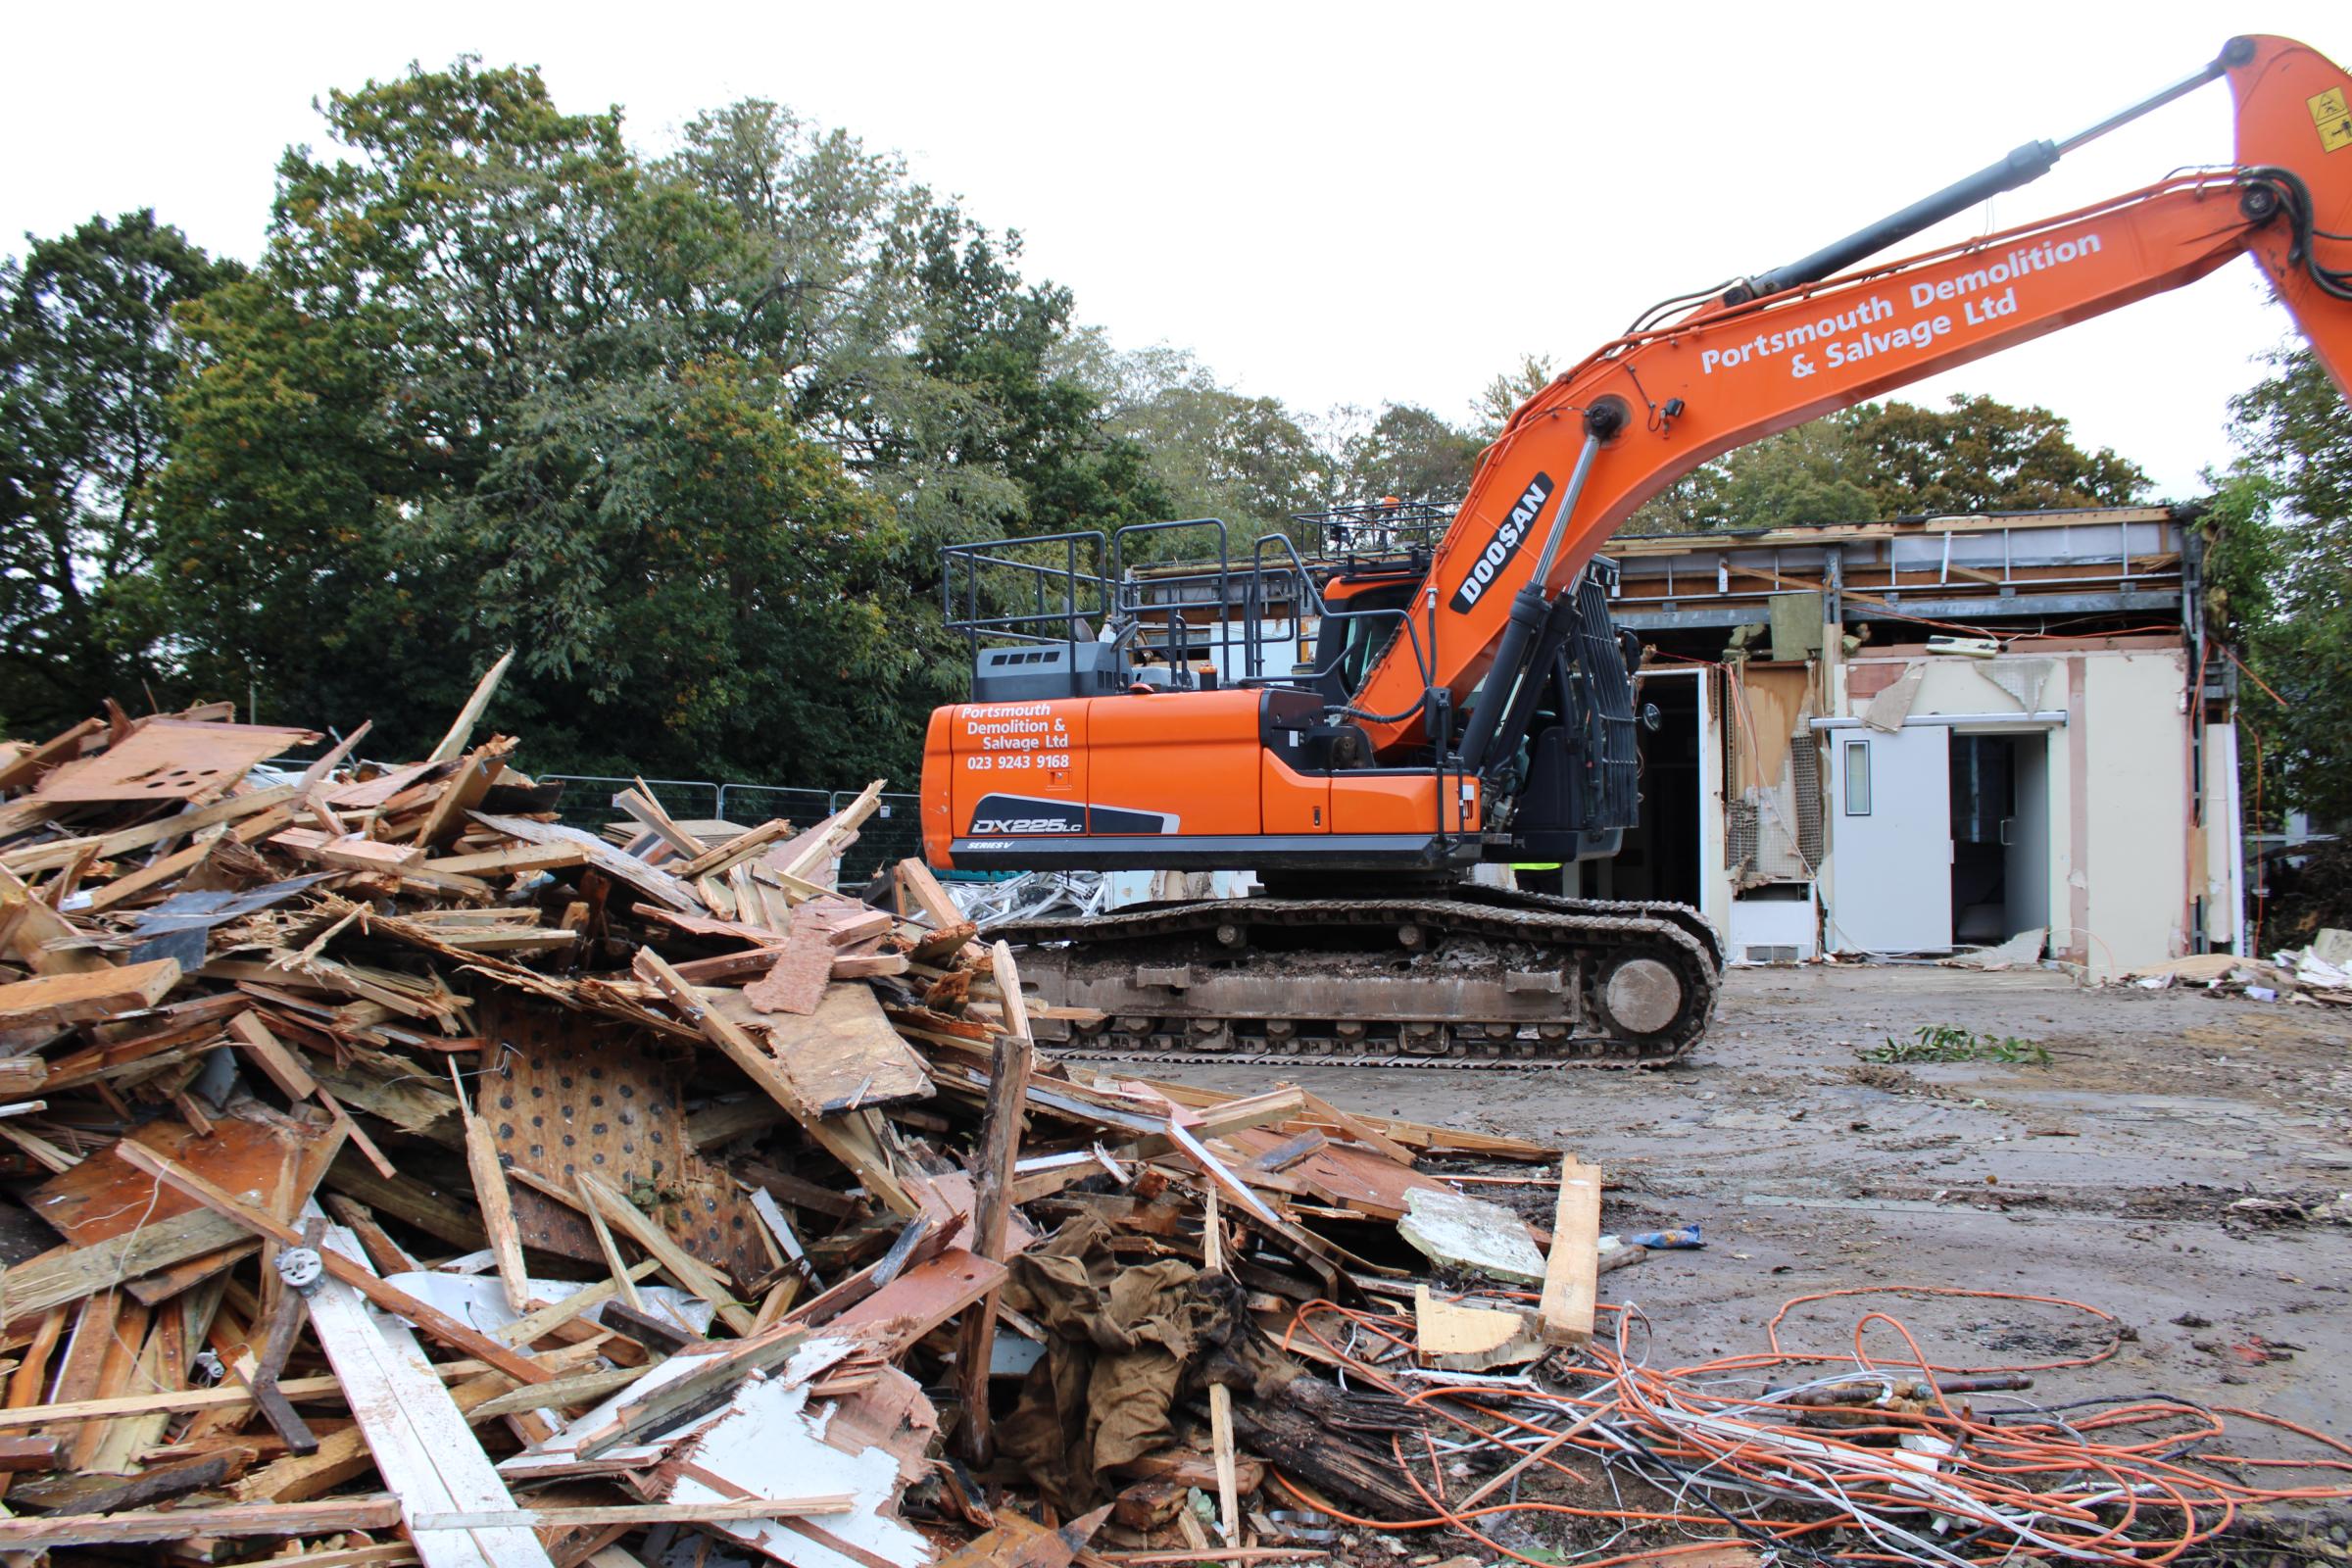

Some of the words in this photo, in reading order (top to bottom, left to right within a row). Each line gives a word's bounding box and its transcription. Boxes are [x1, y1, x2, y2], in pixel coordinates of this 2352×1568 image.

[1701, 296, 1894, 374] Portsmouth
[1910, 233, 2101, 310] Demolition
[1791, 353, 1816, 378] &
[1828, 313, 1952, 368] Salvage
[1964, 287, 2018, 325] Ltd
[1459, 482, 1546, 605] DOOSAN
[961, 704, 1051, 718] Portsmouth
[967, 719, 1049, 734] Demolition
[1054, 717, 1065, 731] &
[983, 736, 1039, 752] Salvage
[1046, 733, 1068, 748] Ltd
[967, 757, 992, 769] 023
[998, 756, 1030, 768] 9243
[1037, 755, 1069, 767] 9168
